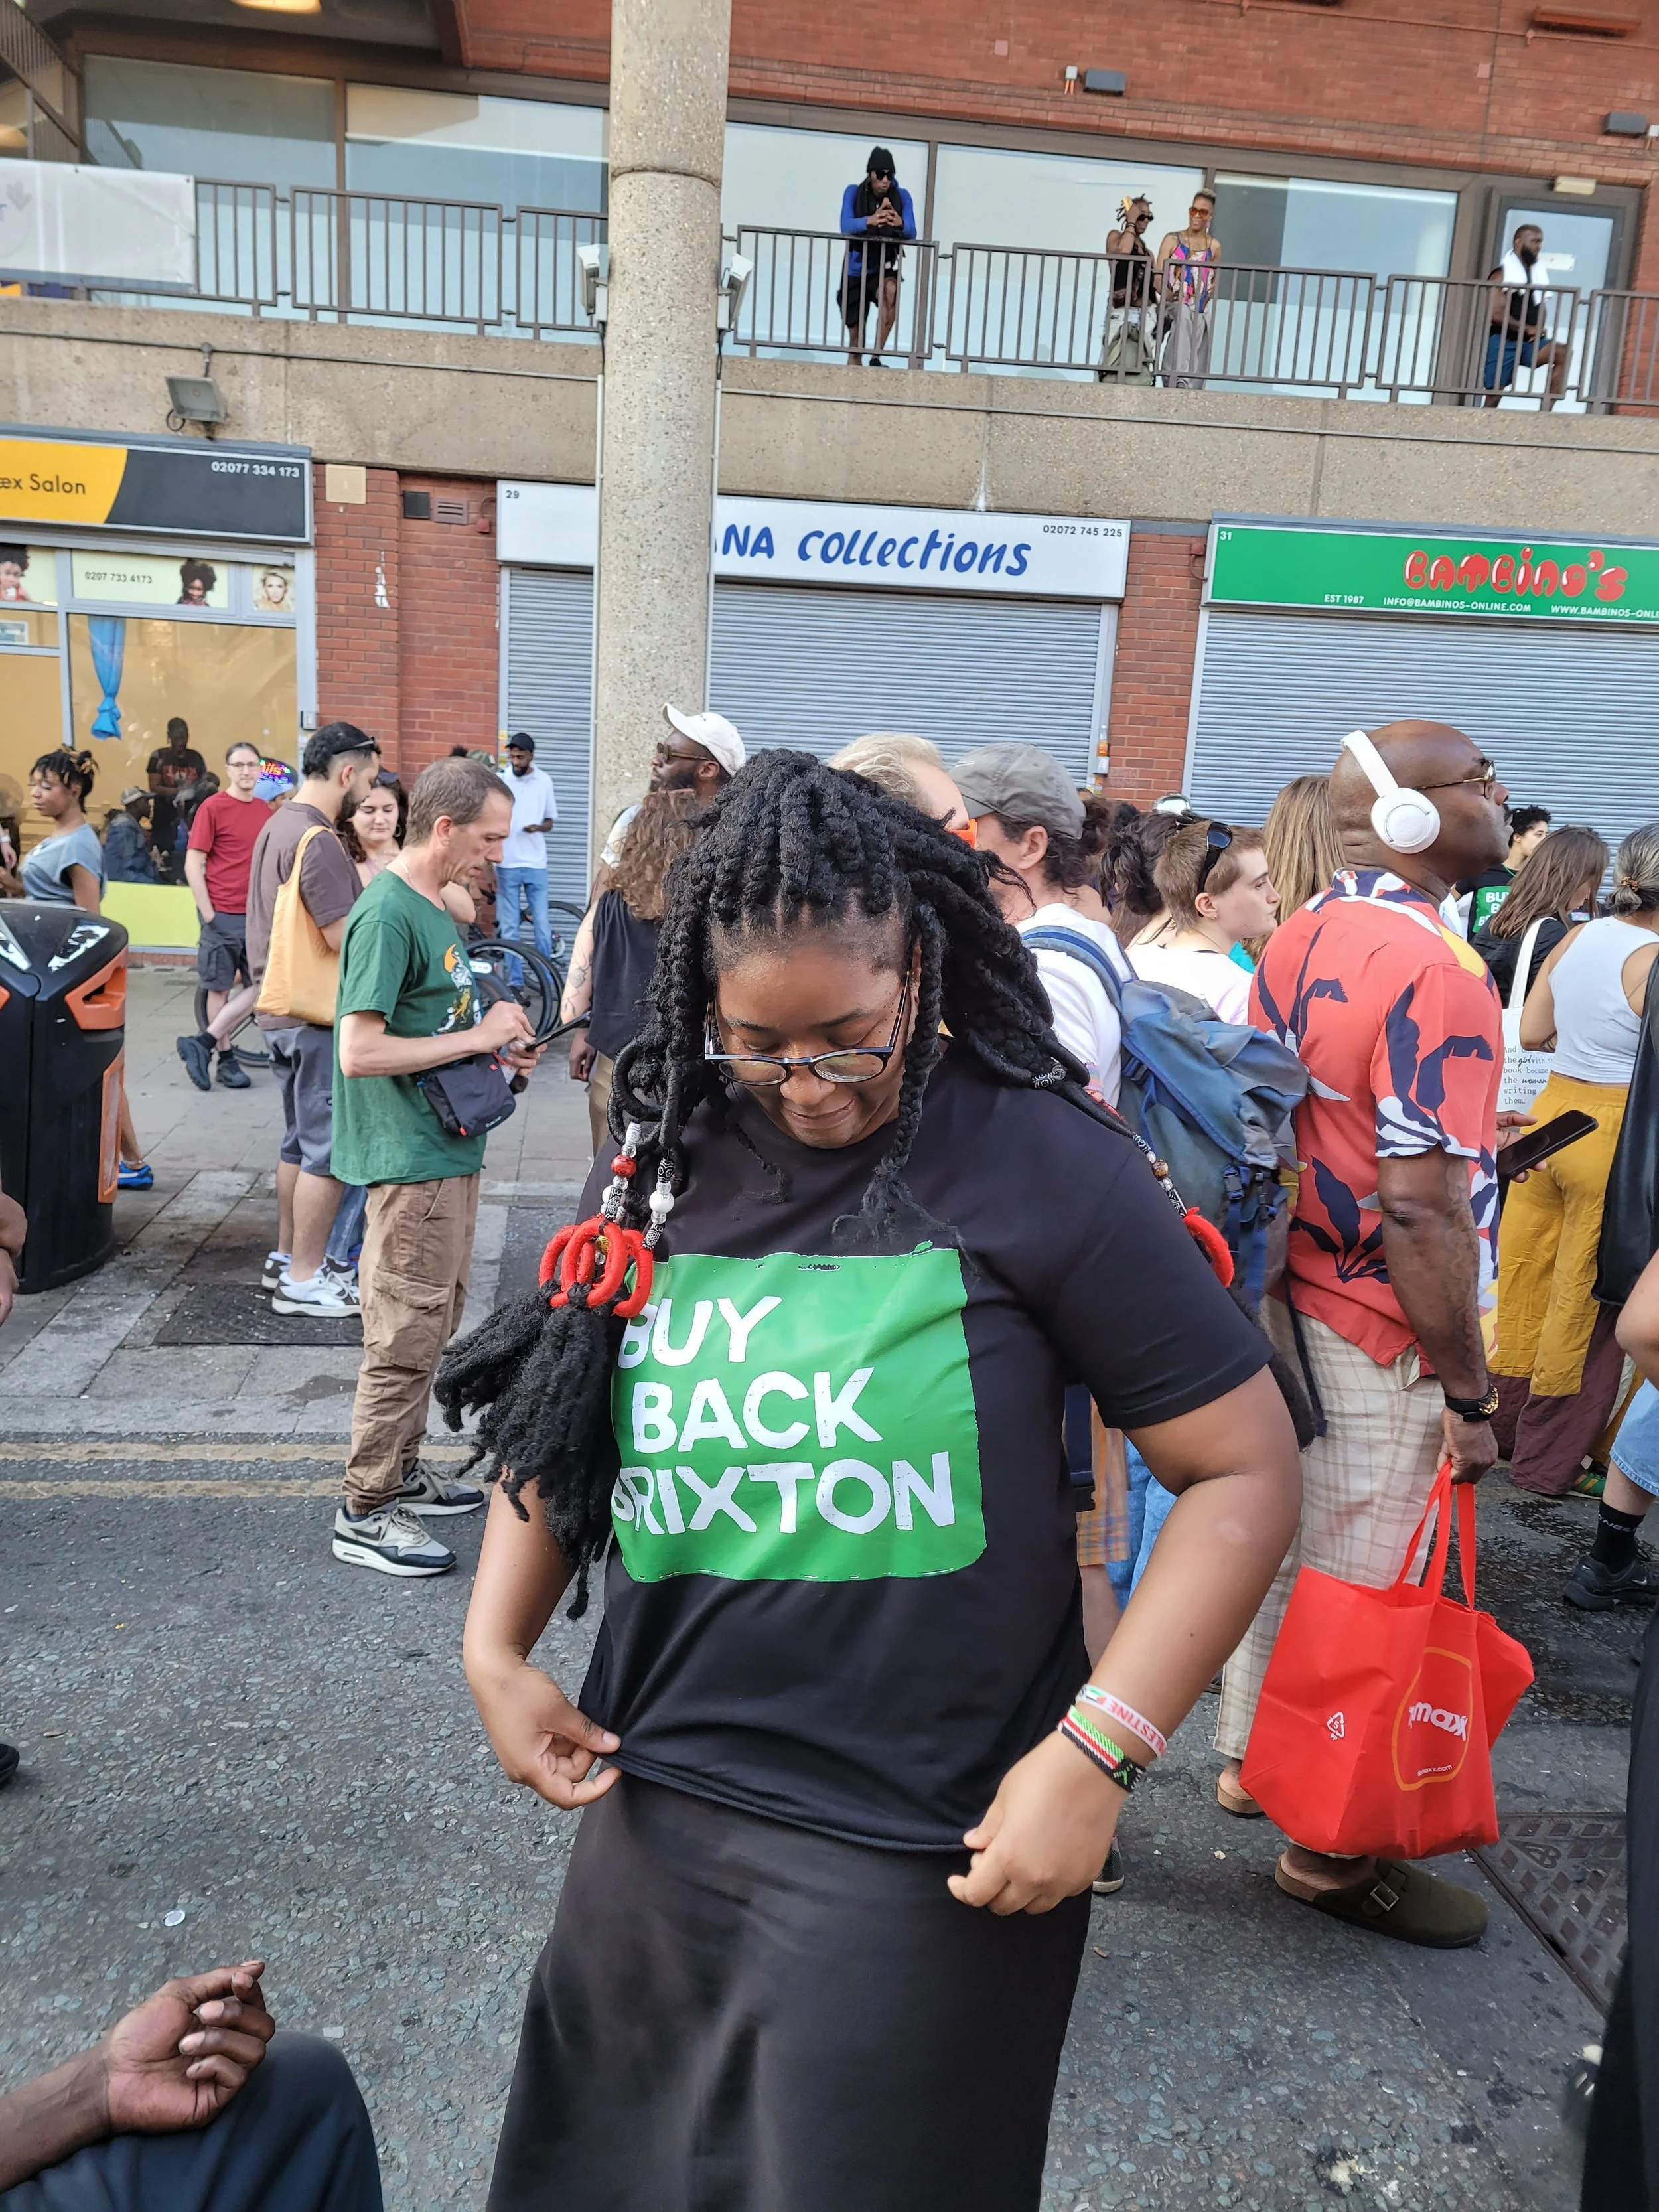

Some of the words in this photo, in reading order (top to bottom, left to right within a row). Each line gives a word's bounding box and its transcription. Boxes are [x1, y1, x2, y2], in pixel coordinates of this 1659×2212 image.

[210, 461, 250, 474] 02077
[252, 464, 276, 476] 334
[279, 466, 300, 478] 173
[30, 474, 86, 494] Salon
[506, 490, 520, 499] 29
[1043, 525, 1076, 535] 02072
[1080, 527, 1099, 536] 745
[1220, 531, 1232, 540] 31
[715, 524, 775, 559] NA
[1324, 594, 1341, 603] EST
[1344, 595, 1364, 604] 1987
[1383, 597, 1532, 612] INFO@BAMBINOS-ONLINE.COM
[618, 1295, 783, 1369] BUY
[632, 1366, 884, 1453] BACK
